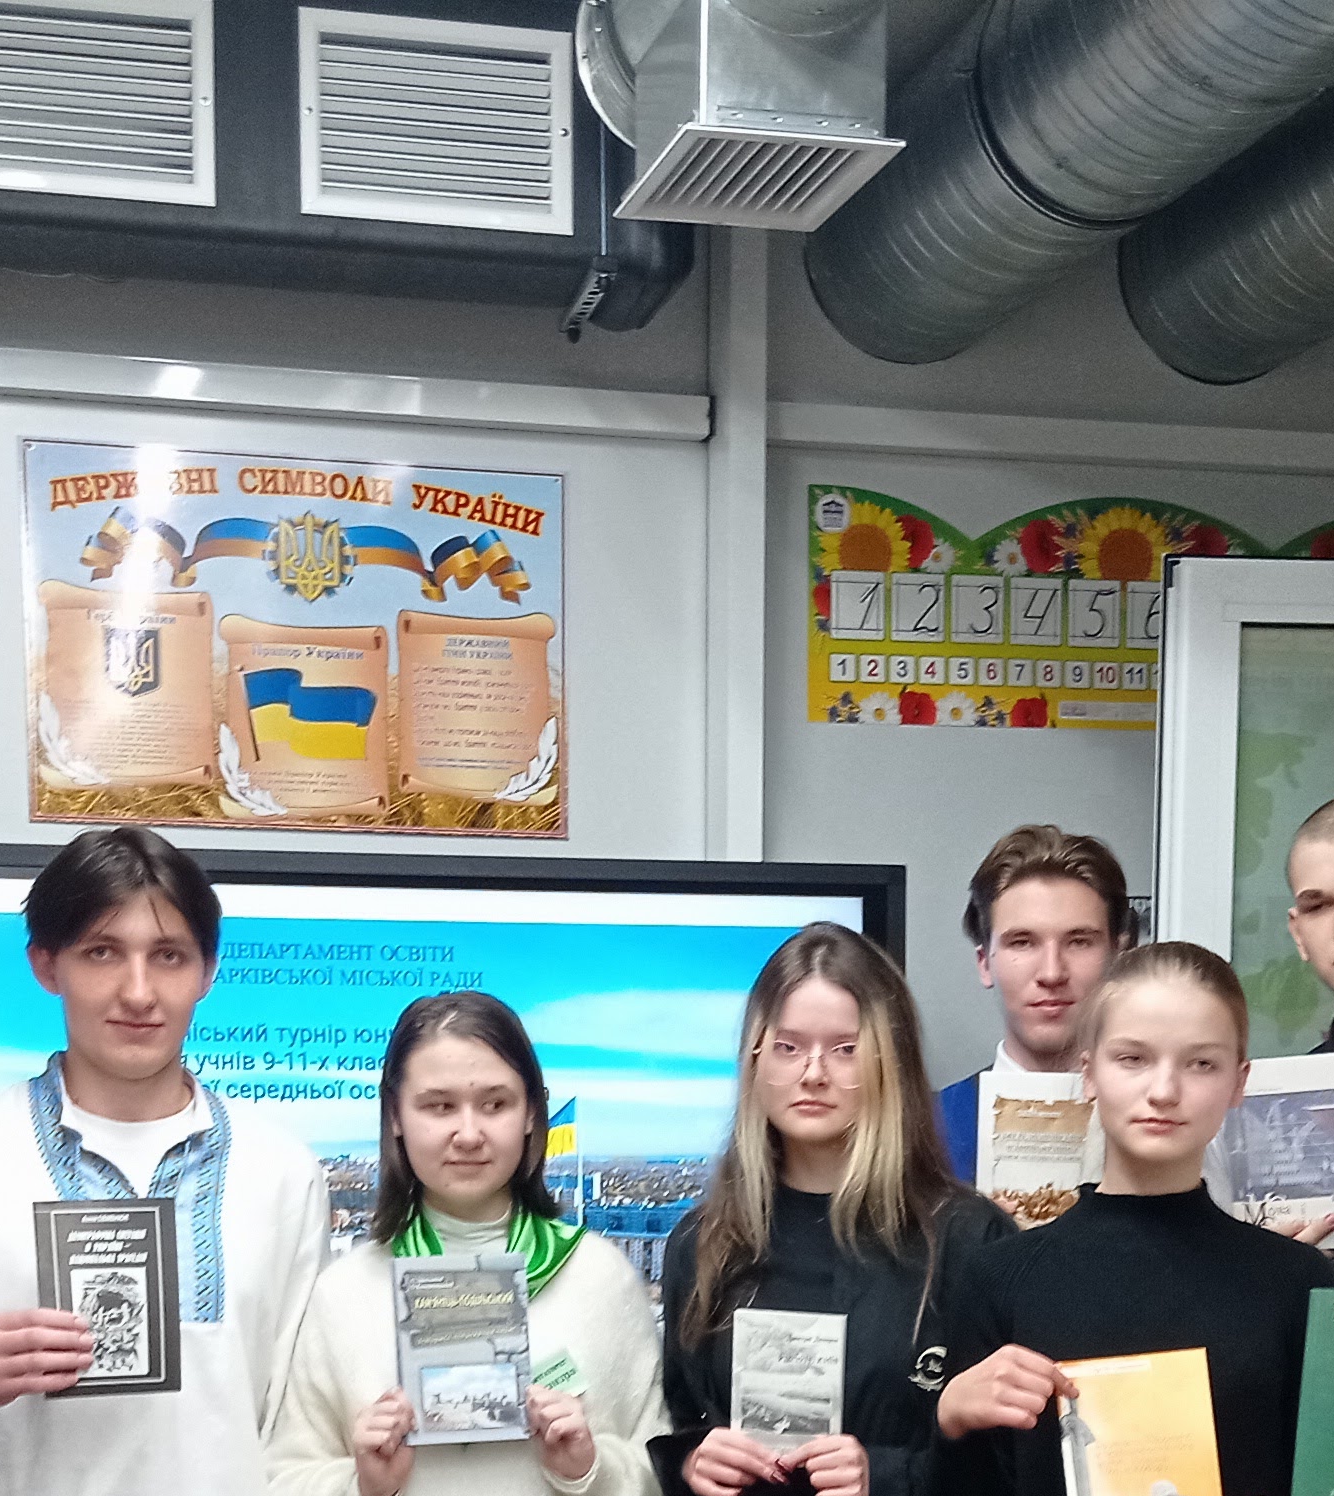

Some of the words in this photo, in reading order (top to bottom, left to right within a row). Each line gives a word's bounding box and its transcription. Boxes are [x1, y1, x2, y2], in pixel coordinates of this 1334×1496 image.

[49, 468, 219, 511] ДЕРЖВНІ
[237, 466, 393, 506] СИМВОЛИ
[411, 484, 545, 536] УКРАЇНИ
[859, 582, 881, 630] 1
[912, 584, 940, 634] 2
[970, 585, 999, 635] 3
[1023, 588, 1058, 635] 4
[1083, 589, 1116, 637] 5
[306, 647, 364, 661] України
[836, 659, 848, 676] 1
[867, 660, 879, 677] 2
[896, 661, 908, 677] 3
[924, 662, 936, 678] 4
[957, 662, 969, 679] 5
[986, 663, 997, 679] 6
[1015, 664, 1026, 680] 7
[1043, 665, 1053, 681] 8
[1072, 666, 1083, 682] 9
[1096, 666, 1116, 683] 10
[1125, 668, 1145, 684] 11
[220, 942, 376, 961] ДЕПАРТАМЕНТ
[380, 945, 455, 963] ОСВІТИ
[213, 968, 332, 986] АРКІВСЬКОЇ
[339, 968, 423, 987] МІСЬКОЇ
[429, 971, 484, 988] РАДИ
[275, 1025, 347, 1048] турнір
[197, 1051, 256, 1075] учнів
[262, 1052, 330, 1071] 9-11-х
[226, 1080, 345, 1103] середньої
[349, 1084, 382, 1100] ос
